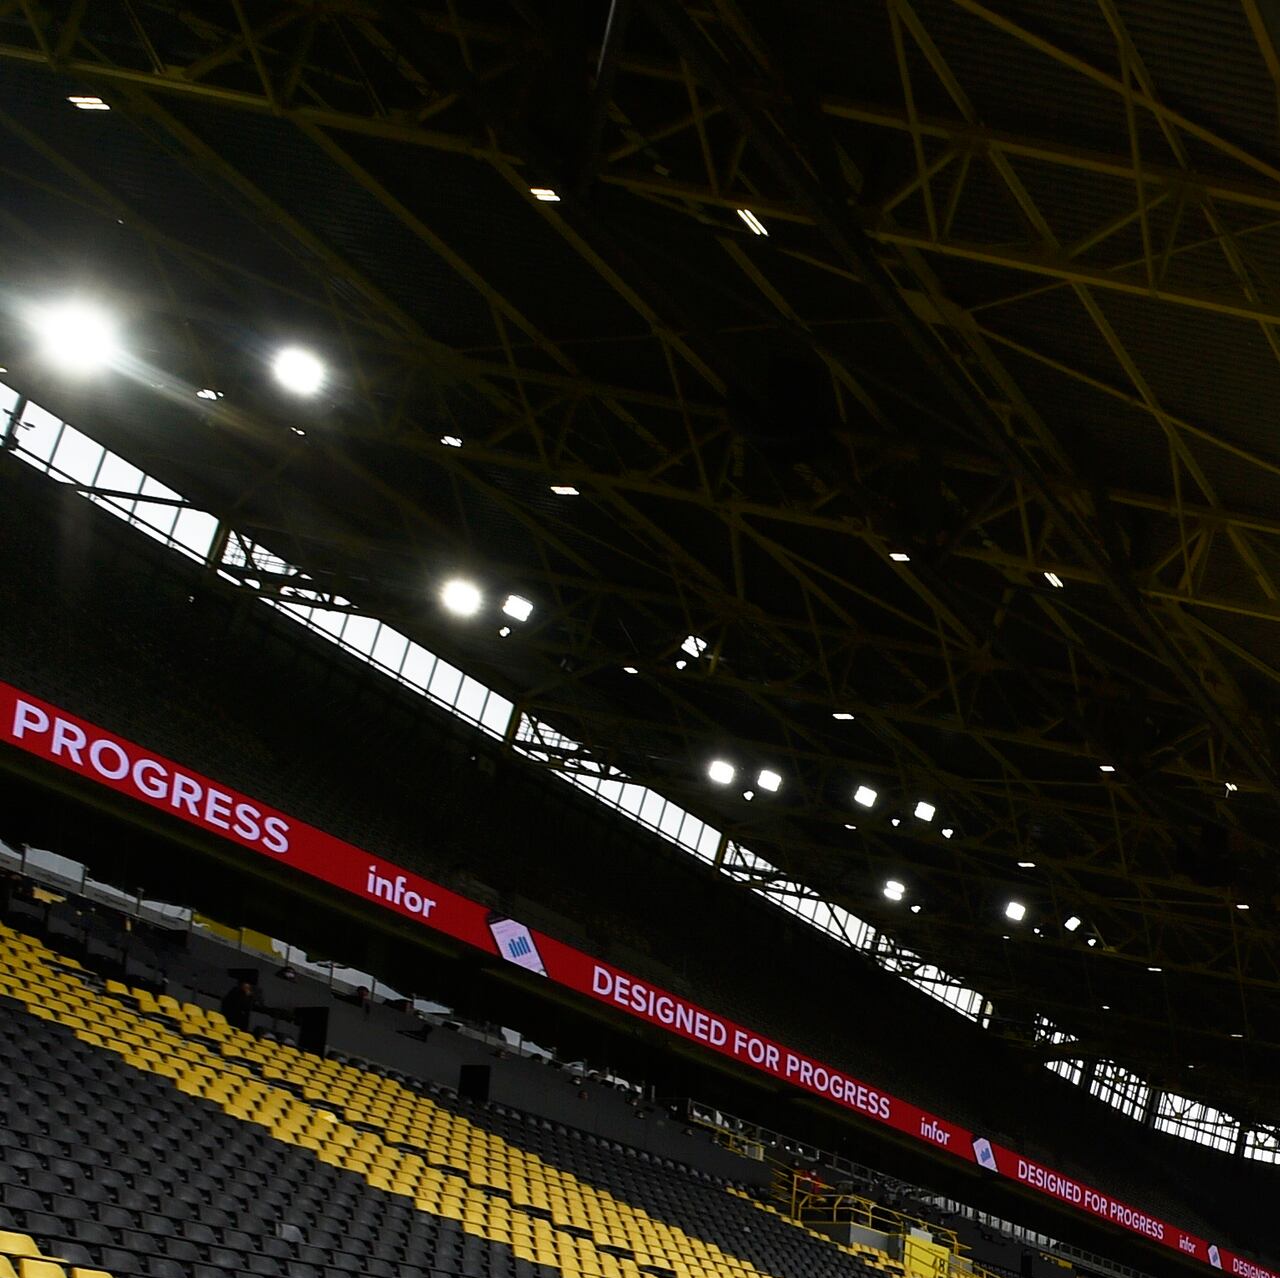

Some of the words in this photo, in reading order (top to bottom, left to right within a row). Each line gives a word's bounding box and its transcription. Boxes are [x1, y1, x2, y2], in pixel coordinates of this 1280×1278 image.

[11, 698, 291, 854] PROGRESS
[367, 863, 437, 919] infor
[592, 965, 727, 1047] DESIGNED
[734, 1029, 780, 1072] FOR
[785, 1053, 891, 1120] PROGRESS
[919, 1117, 951, 1147] infor
[1017, 1158, 1082, 1204] DESIGNED
[1084, 1189, 1108, 1217] FOR
[1109, 1201, 1165, 1241] PROGRESS
